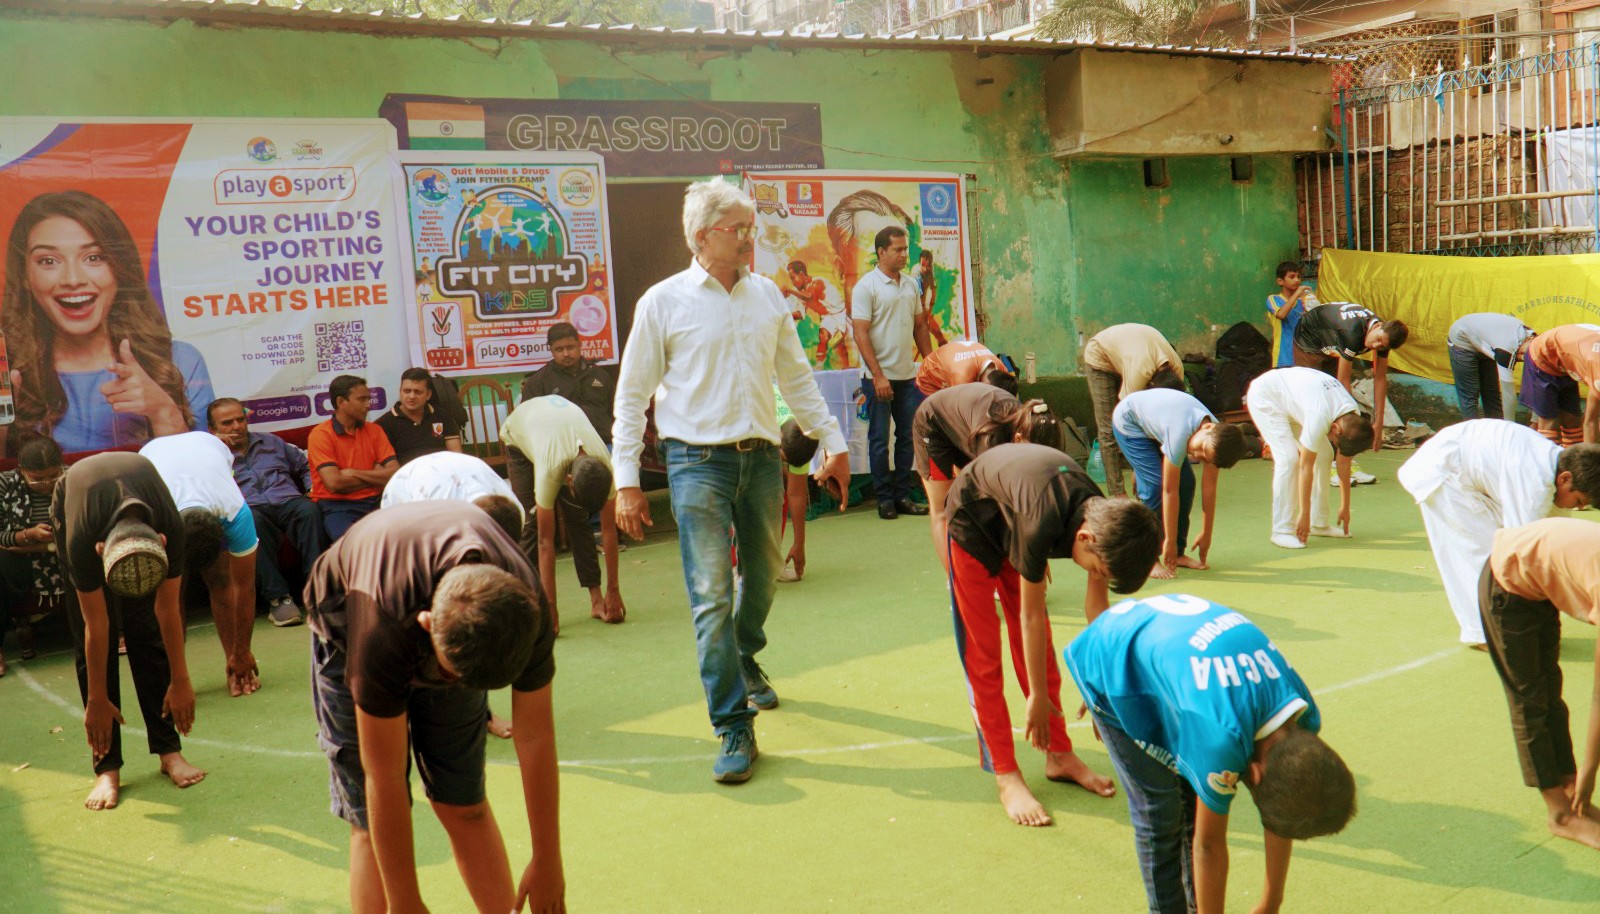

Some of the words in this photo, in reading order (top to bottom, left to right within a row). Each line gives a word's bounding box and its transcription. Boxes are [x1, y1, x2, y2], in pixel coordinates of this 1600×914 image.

[506, 114, 788, 152] GRASSROOT
[222, 176, 267, 198] play
[293, 174, 347, 195] sport
[798, 184, 812, 202] B
[184, 215, 268, 238] YOUR
[272, 210, 381, 234] CHILD'S
[242, 236, 383, 262] SPORTING
[256, 261, 384, 288] JOURNEY
[450, 266, 499, 286] FIT
[508, 264, 576, 284] CITY
[183, 290, 308, 318] STARTS
[315, 284, 388, 309] HERE
[484, 289, 548, 312] KIDS
[1516, 296, 1563, 314] WARRIORS
[260, 335, 285, 343] SCAN
[286, 333, 303, 342] THE
[255, 349, 304, 360] DOWNLOAD
[289, 356, 305, 364] APP
[480, 345, 506, 359] play
[520, 343, 550, 356] sport
[290, 384, 322, 392] Available
[256, 406, 289, 416] Google
[290, 404, 308, 414] Play
[1189, 650, 1282, 690] BCHA
